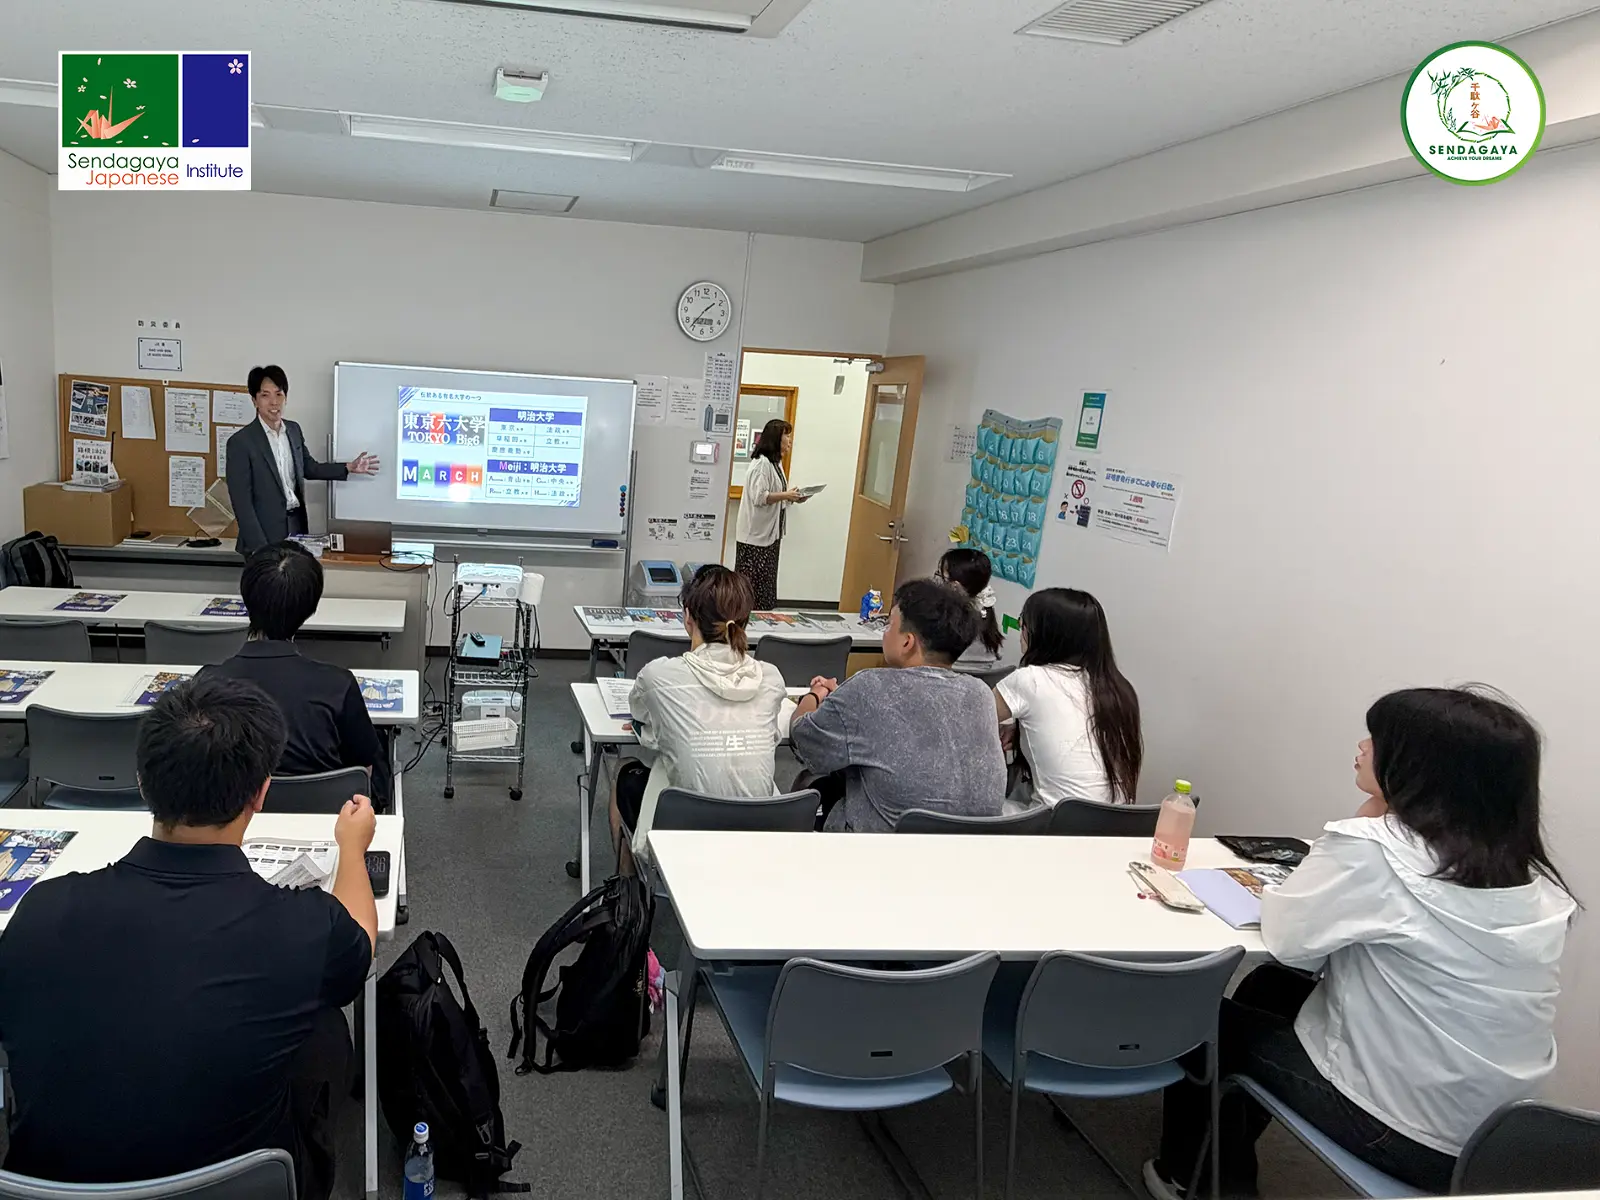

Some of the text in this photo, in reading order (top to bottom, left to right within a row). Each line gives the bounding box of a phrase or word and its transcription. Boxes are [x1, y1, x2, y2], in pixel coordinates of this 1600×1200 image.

[517, 410, 555, 423] 明治大学
[403, 411, 486, 434] 東京六大学
[407, 431, 480, 447] TOKYO Big6
[1038, 450, 1045, 461] 6
[1027, 511, 1037, 522] 18
[1006, 537, 1017, 548] 23
[1022, 542, 1032, 553] 24
